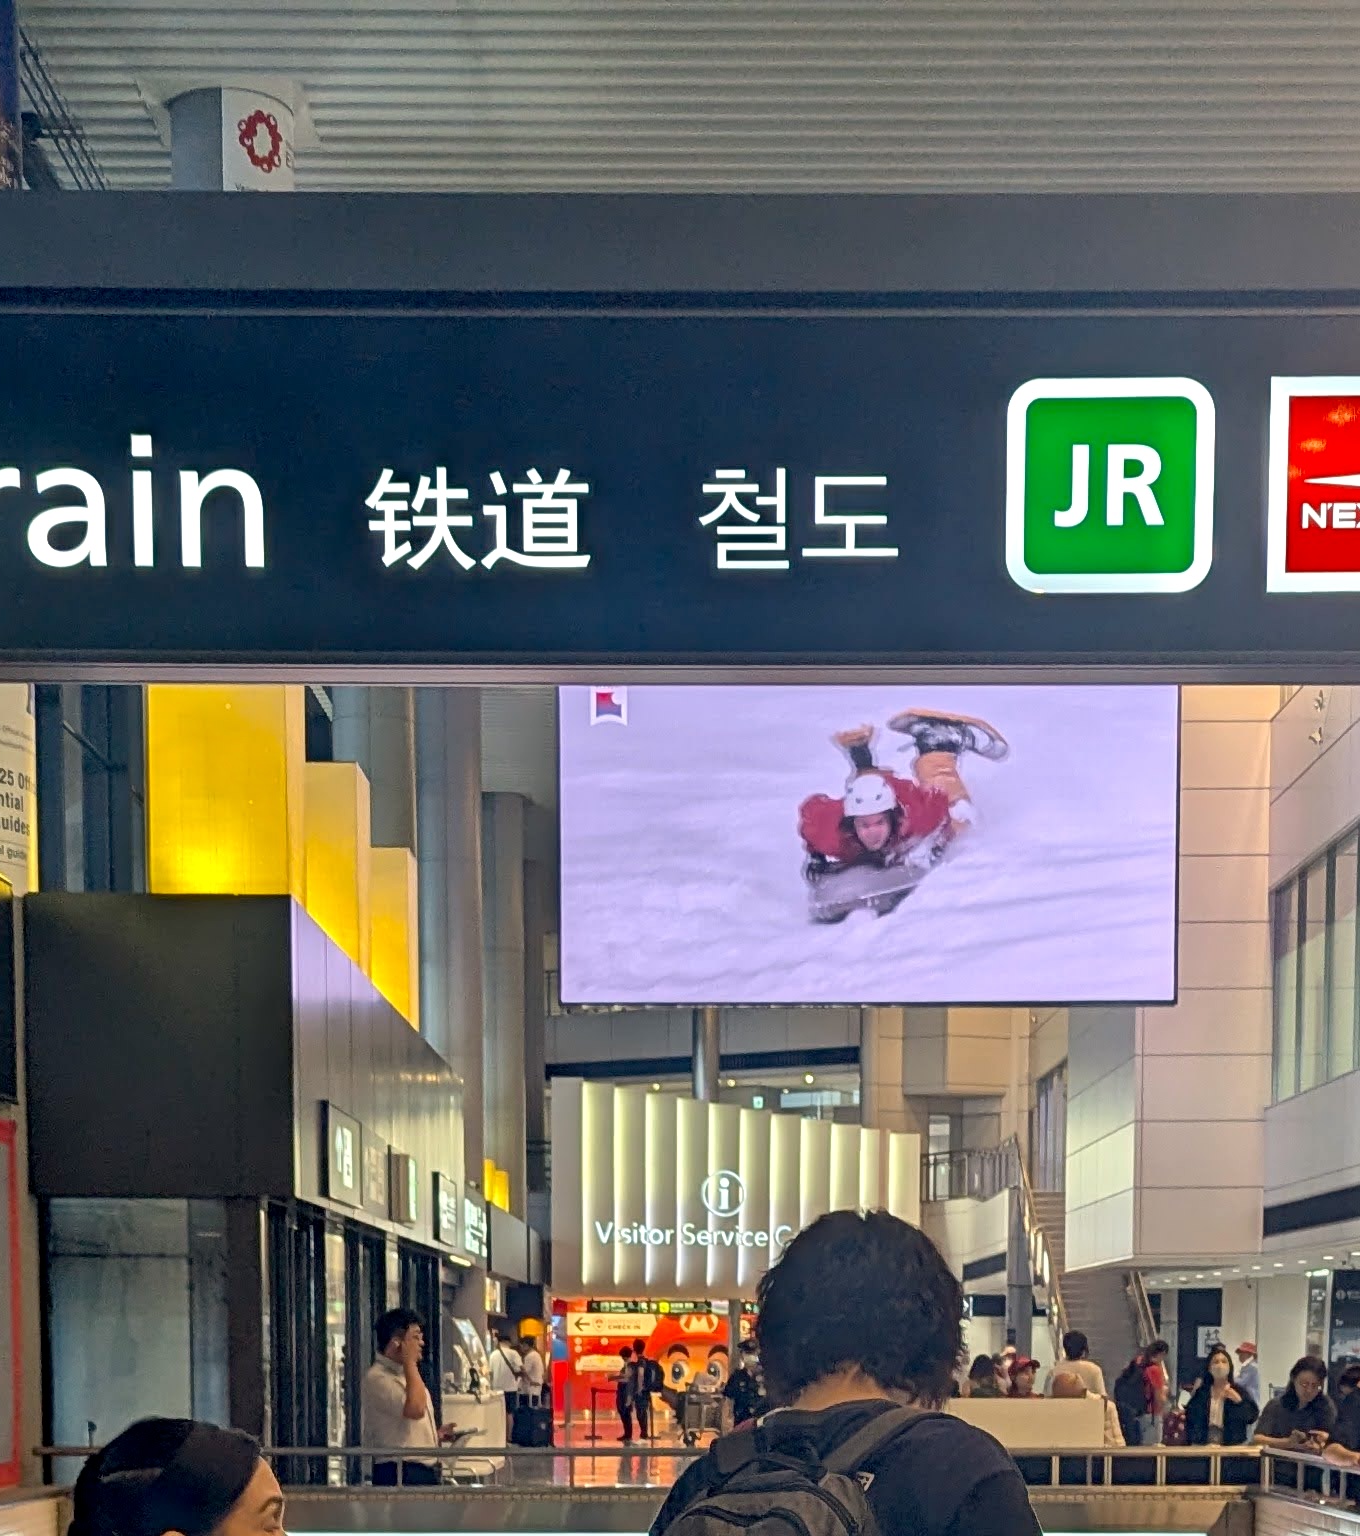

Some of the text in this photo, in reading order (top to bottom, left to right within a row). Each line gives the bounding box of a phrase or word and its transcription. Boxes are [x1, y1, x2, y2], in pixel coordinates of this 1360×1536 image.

[364, 466, 593, 571] 铁道
[697, 466, 900, 571] 철도
[1054, 441, 1166, 530] JR
[595, 1221, 674, 1246] Visitor
[682, 1223, 769, 1247] Service
